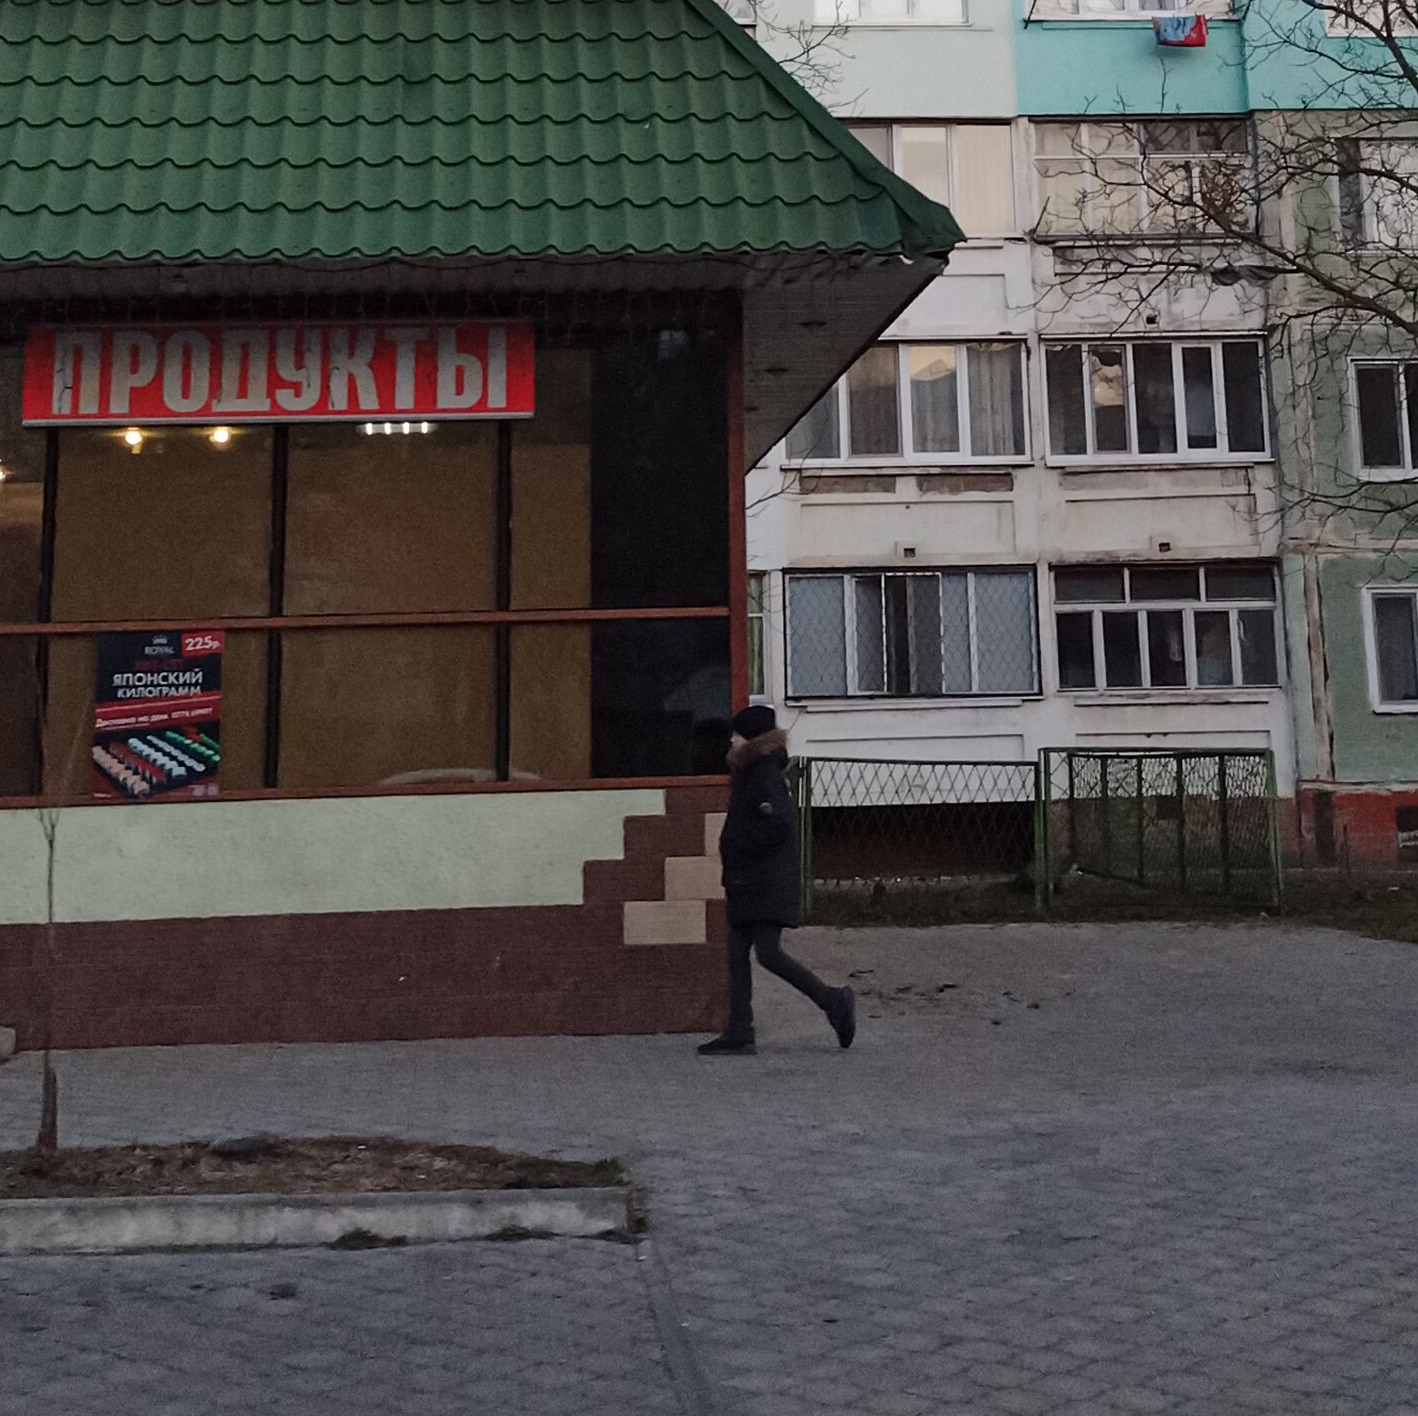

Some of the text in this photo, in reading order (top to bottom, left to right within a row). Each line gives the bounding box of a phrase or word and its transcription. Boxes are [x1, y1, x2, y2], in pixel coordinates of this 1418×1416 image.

[52, 325, 507, 415] ПРОДУКТЫ
[112, 667, 204, 687] ЯПОНСКИЙ
[116, 685, 202, 699] КИЛОГРАММ
